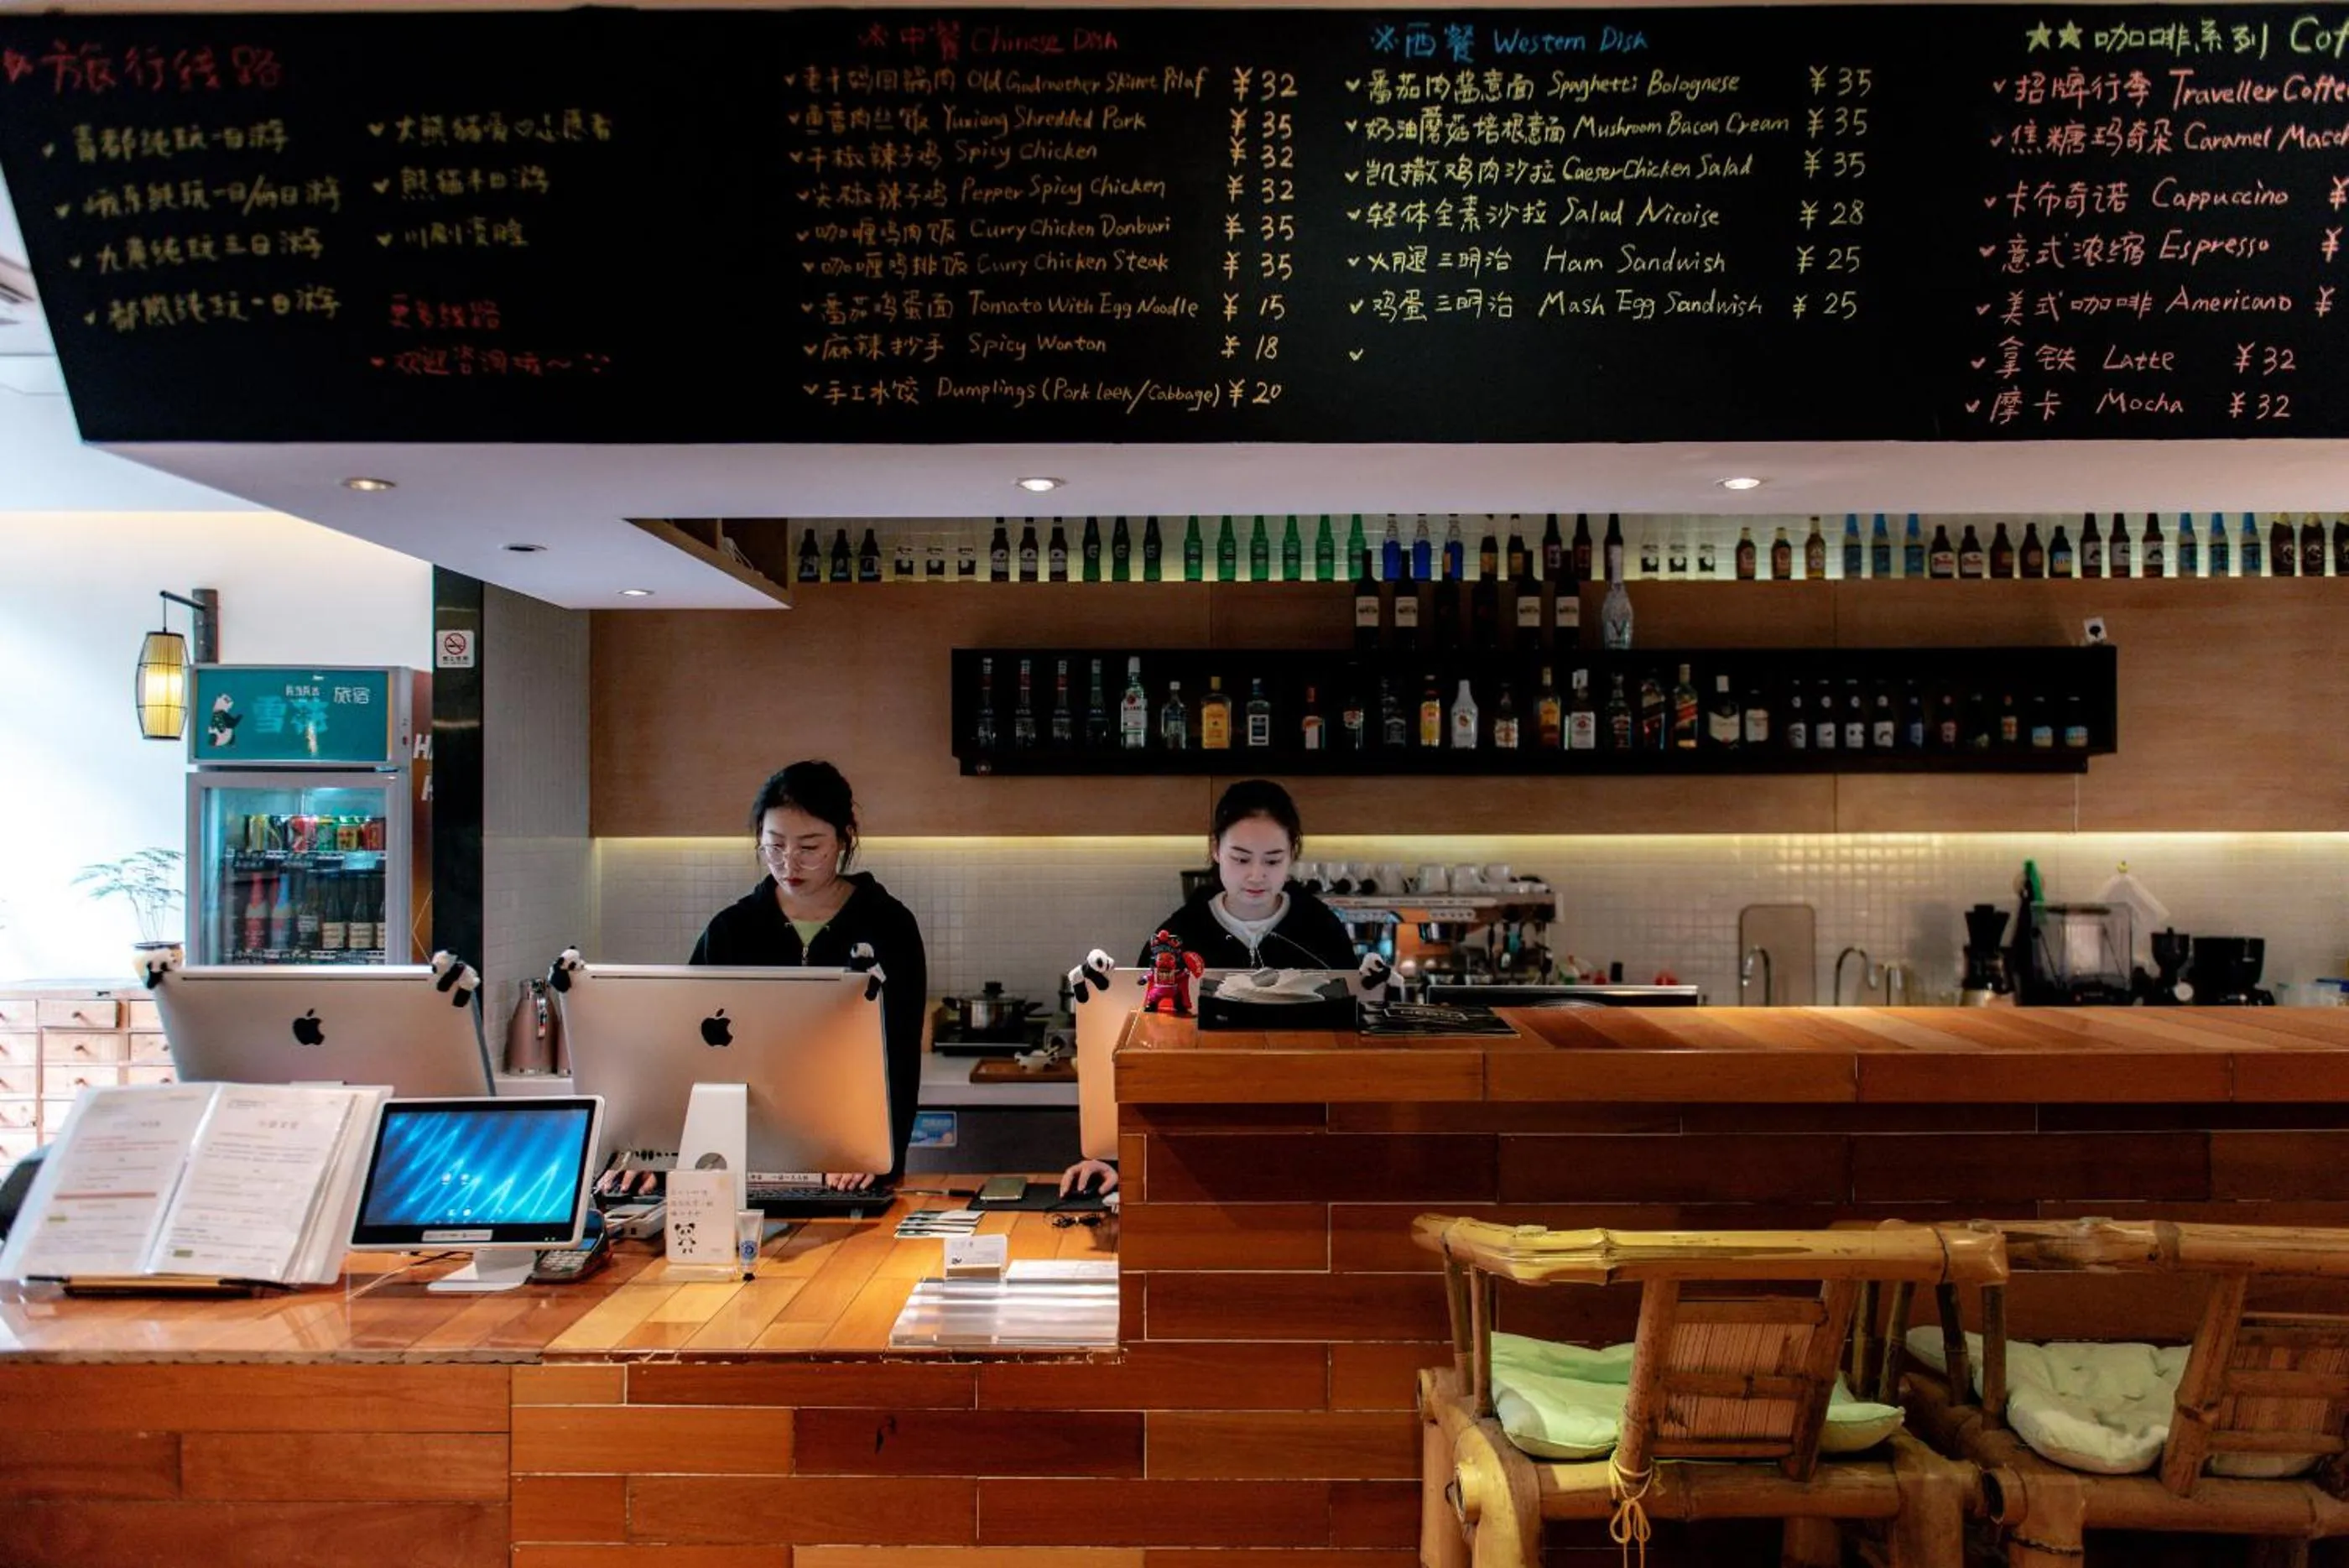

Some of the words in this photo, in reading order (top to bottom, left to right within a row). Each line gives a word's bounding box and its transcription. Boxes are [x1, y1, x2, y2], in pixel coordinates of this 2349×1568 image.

[1404, 22, 1476, 64] 西餐
[1493, 28, 1586, 55] Western
[2094, 18, 2268, 60] 咖啡系列
[1261, 70, 1299, 102] 32
[1367, 67, 1535, 106] 番茄肉酱意面
[1548, 69, 1638, 102] Spaghetti
[1647, 68, 1741, 102] Bolognese
[1837, 67, 1873, 98] 35
[2013, 65, 2153, 111] 招牌行李
[2168, 68, 2279, 112] Traveller
[1102, 107, 1147, 131] Pork
[1261, 111, 1293, 139] 35
[1364, 105, 1565, 148] 奶油蘑菇培根意面
[1573, 116, 1660, 140] Mushroom
[1667, 111, 1720, 138] Bacon
[1726, 112, 1789, 137] Cream
[1834, 107, 1869, 137] 35
[2010, 116, 2174, 159] 焦糖玛奇朵
[2184, 121, 2272, 153] Caramel
[954, 139, 1011, 171] Spicy
[1018, 141, 1097, 161] Chicken
[1261, 144, 1294, 169] 32
[1366, 153, 1556, 190] 凯撒鸡肉沙拉
[1695, 153, 1754, 180] Salad
[1832, 151, 1866, 179] 35
[1029, 174, 1084, 206] Spicy
[1090, 176, 1166, 199] Chicken
[1261, 178, 1295, 204] 32
[2006, 180, 2130, 219] 卡布奇诺
[2151, 176, 2289, 211] Cappuccino
[970, 218, 1027, 242] Curry
[1030, 218, 1095, 238] Chicken
[1261, 215, 1295, 242] 35
[1366, 194, 1549, 233] 轻体全素沙拉
[1559, 195, 1625, 227] Salad
[1828, 200, 1865, 226] 28
[977, 253, 1028, 277] Curry
[1033, 253, 1107, 273] Chicken
[1114, 249, 1169, 273] Steak
[1260, 253, 1294, 281] 35
[1367, 244, 1513, 279] 火腿三明治
[1544, 243, 1604, 273] Ham
[1617, 242, 1727, 274] Sandwish
[1826, 246, 1862, 273] 25
[2000, 230, 2146, 274] 意式浓缩
[2159, 228, 2270, 266] Espresso
[969, 289, 1042, 315] Tomato
[1048, 296, 1094, 315] With
[1100, 292, 1132, 320] Egg
[1138, 295, 1201, 319] Noodle
[1259, 294, 1285, 320] 15
[1372, 289, 1514, 325] 鸡蛋三明治
[1537, 289, 1607, 319] Mash
[1616, 289, 1656, 320] Egg
[1666, 288, 1763, 320] Sandwish
[1823, 291, 1858, 320] 25
[1998, 289, 2154, 326] 美式咖啡
[2166, 284, 2292, 315] Americano
[821, 332, 945, 363] 麻辣抄手
[968, 332, 1027, 362] Spicy
[1255, 336, 1279, 362] 18
[1994, 336, 2077, 380] 拿铁
[2102, 343, 2179, 372] Latte
[2263, 346, 2297, 376] 32
[822, 376, 920, 407] 手工水饺
[937, 376, 1037, 409] Dumplings
[1252, 381, 1283, 404] 20
[1989, 386, 2063, 426] 摩卡
[2095, 388, 2185, 415] Mocha
[2255, 394, 2291, 421] 32
